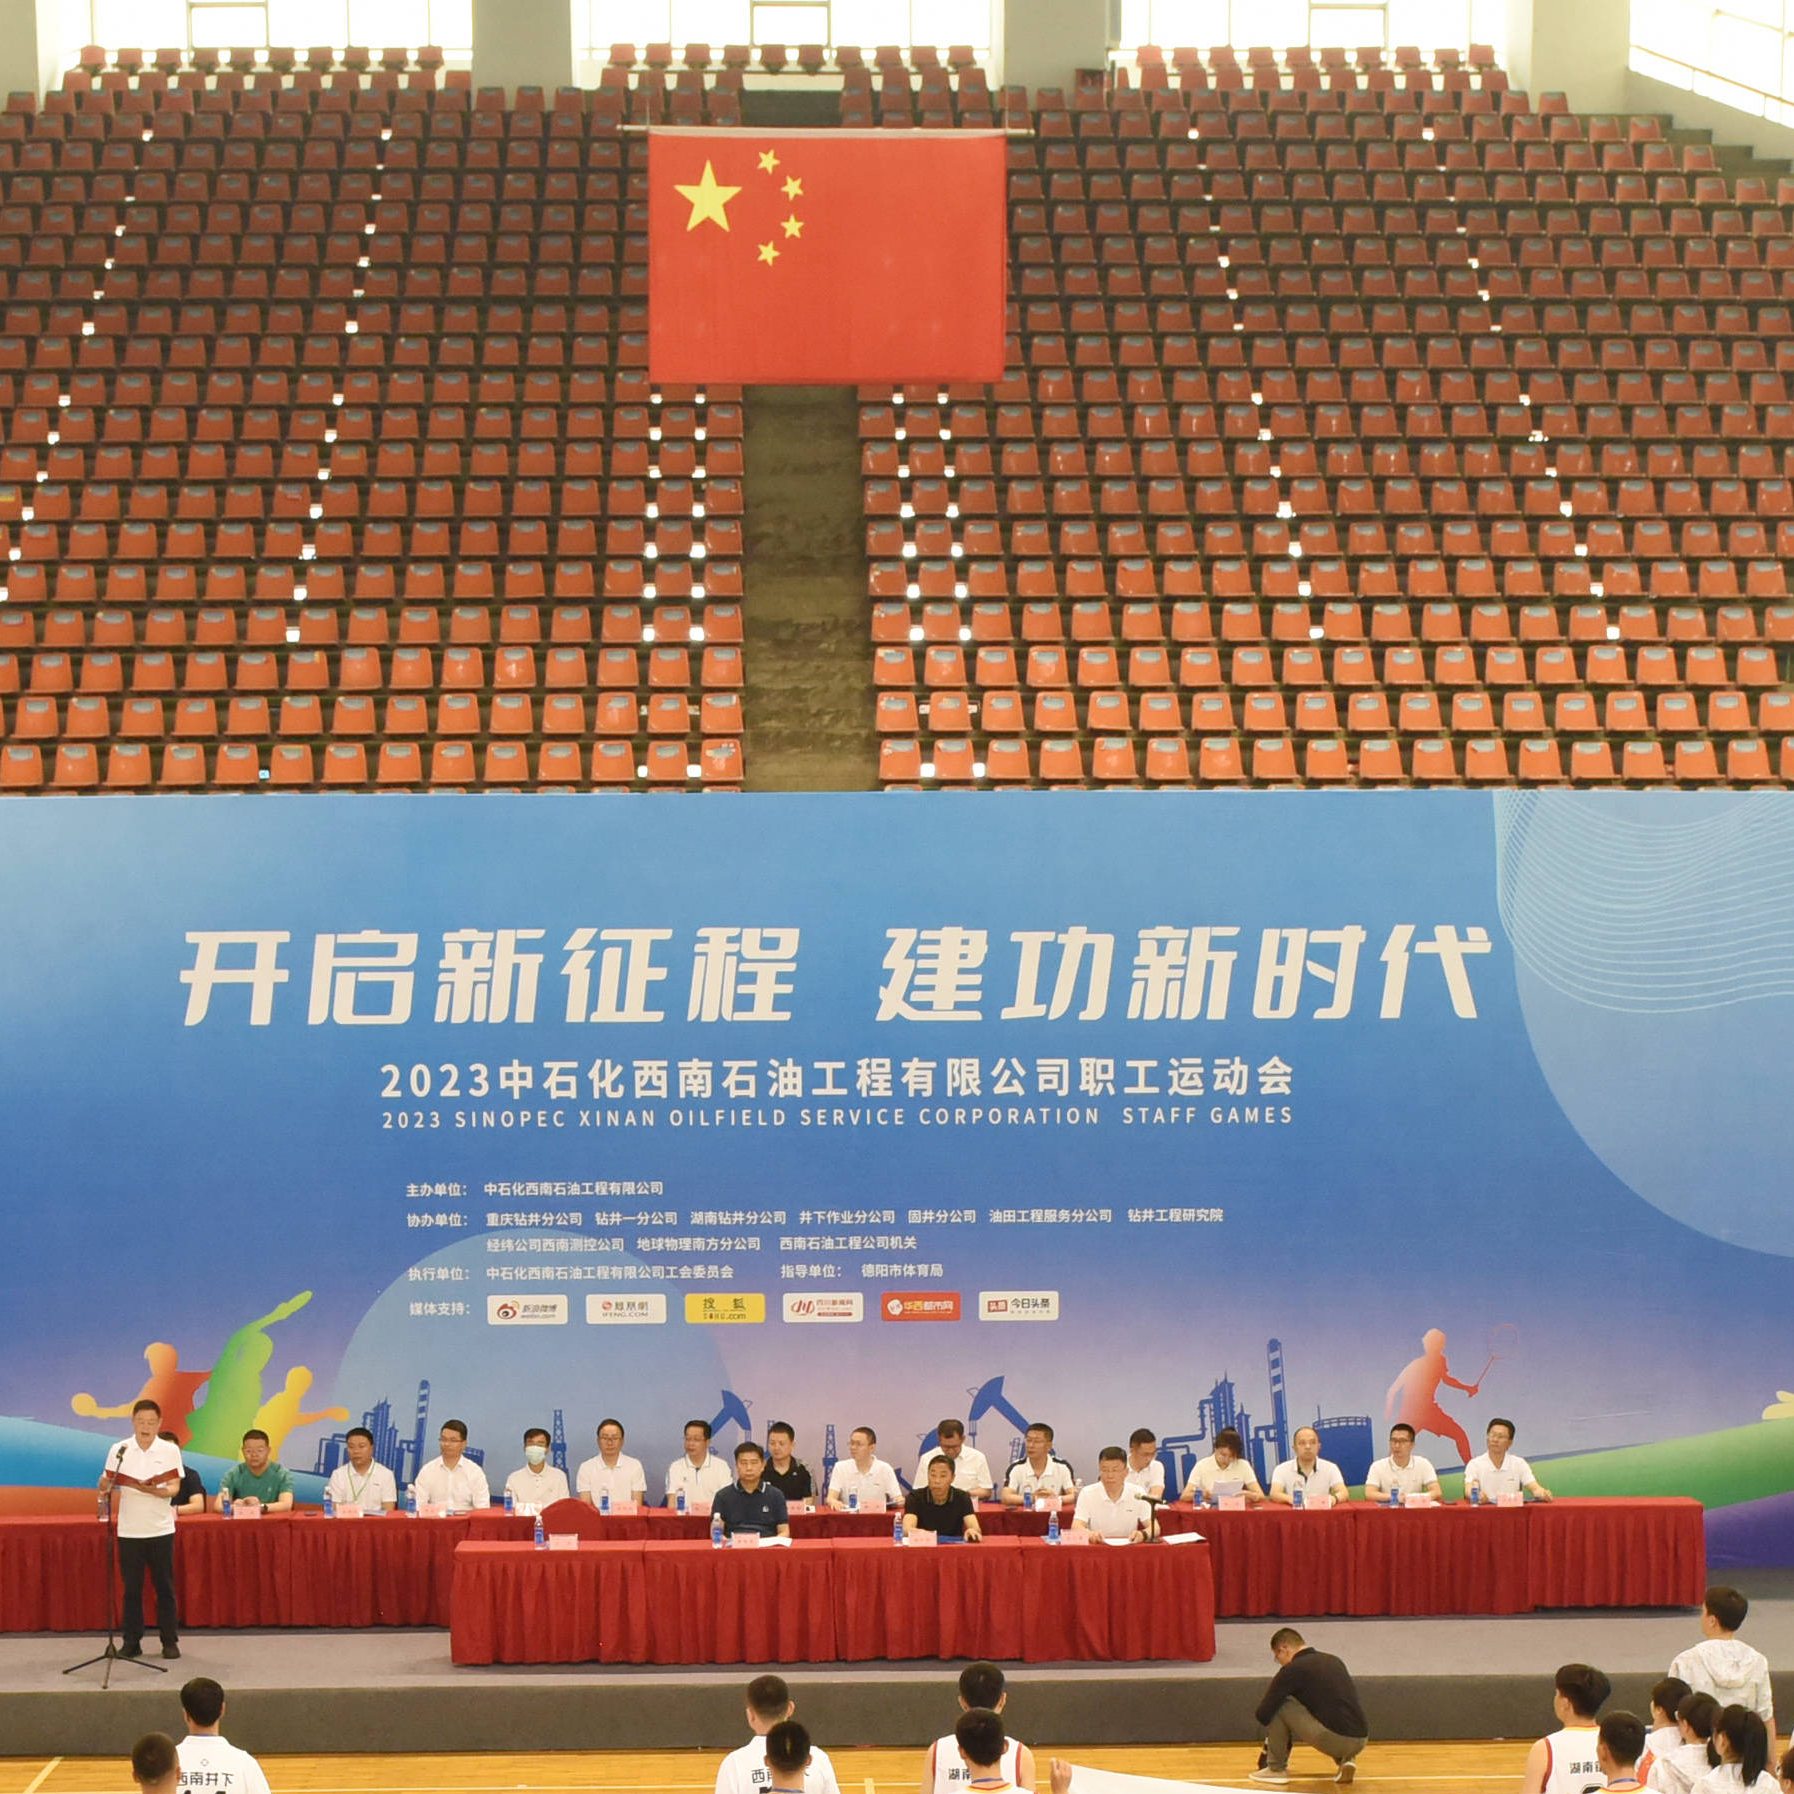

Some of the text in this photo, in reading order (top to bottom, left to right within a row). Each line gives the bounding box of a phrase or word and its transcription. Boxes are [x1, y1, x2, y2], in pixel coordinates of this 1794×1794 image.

[179, 925, 1492, 1026] 开启新征程 建功新时代
[380, 1056, 1294, 1099] 2023中石化西南石油工程有限公司职工运动会
[382, 1106, 1292, 1129] 2023 SINOPEC XINAN OILFIELD SERVICE CORPORATION STAFF GAMES
[484, 1182, 663, 1196] 中石化西南石油工程有限公司
[486, 1212, 583, 1227] 重庆钻井分公司
[595, 1212, 678, 1226] 钻井一分公司
[690, 1211, 787, 1226] 湖南钻井分公司
[799, 1210, 895, 1225] 井下作业分公司
[908, 1210, 976, 1224] 固井分公司
[989, 1209, 1112, 1223] 油田工程服务分公司
[1127, 1208, 1224, 1223] 钻井工程研究院
[486, 1236, 917, 1253] 经纬公司西南测控公司 地球物理南方分公司 西南石油工程公司机关
[486, 1265, 734, 1281] 中石化西南石油工程有限公司工会委员会
[861, 1264, 943, 1279] 德阳市体育局
